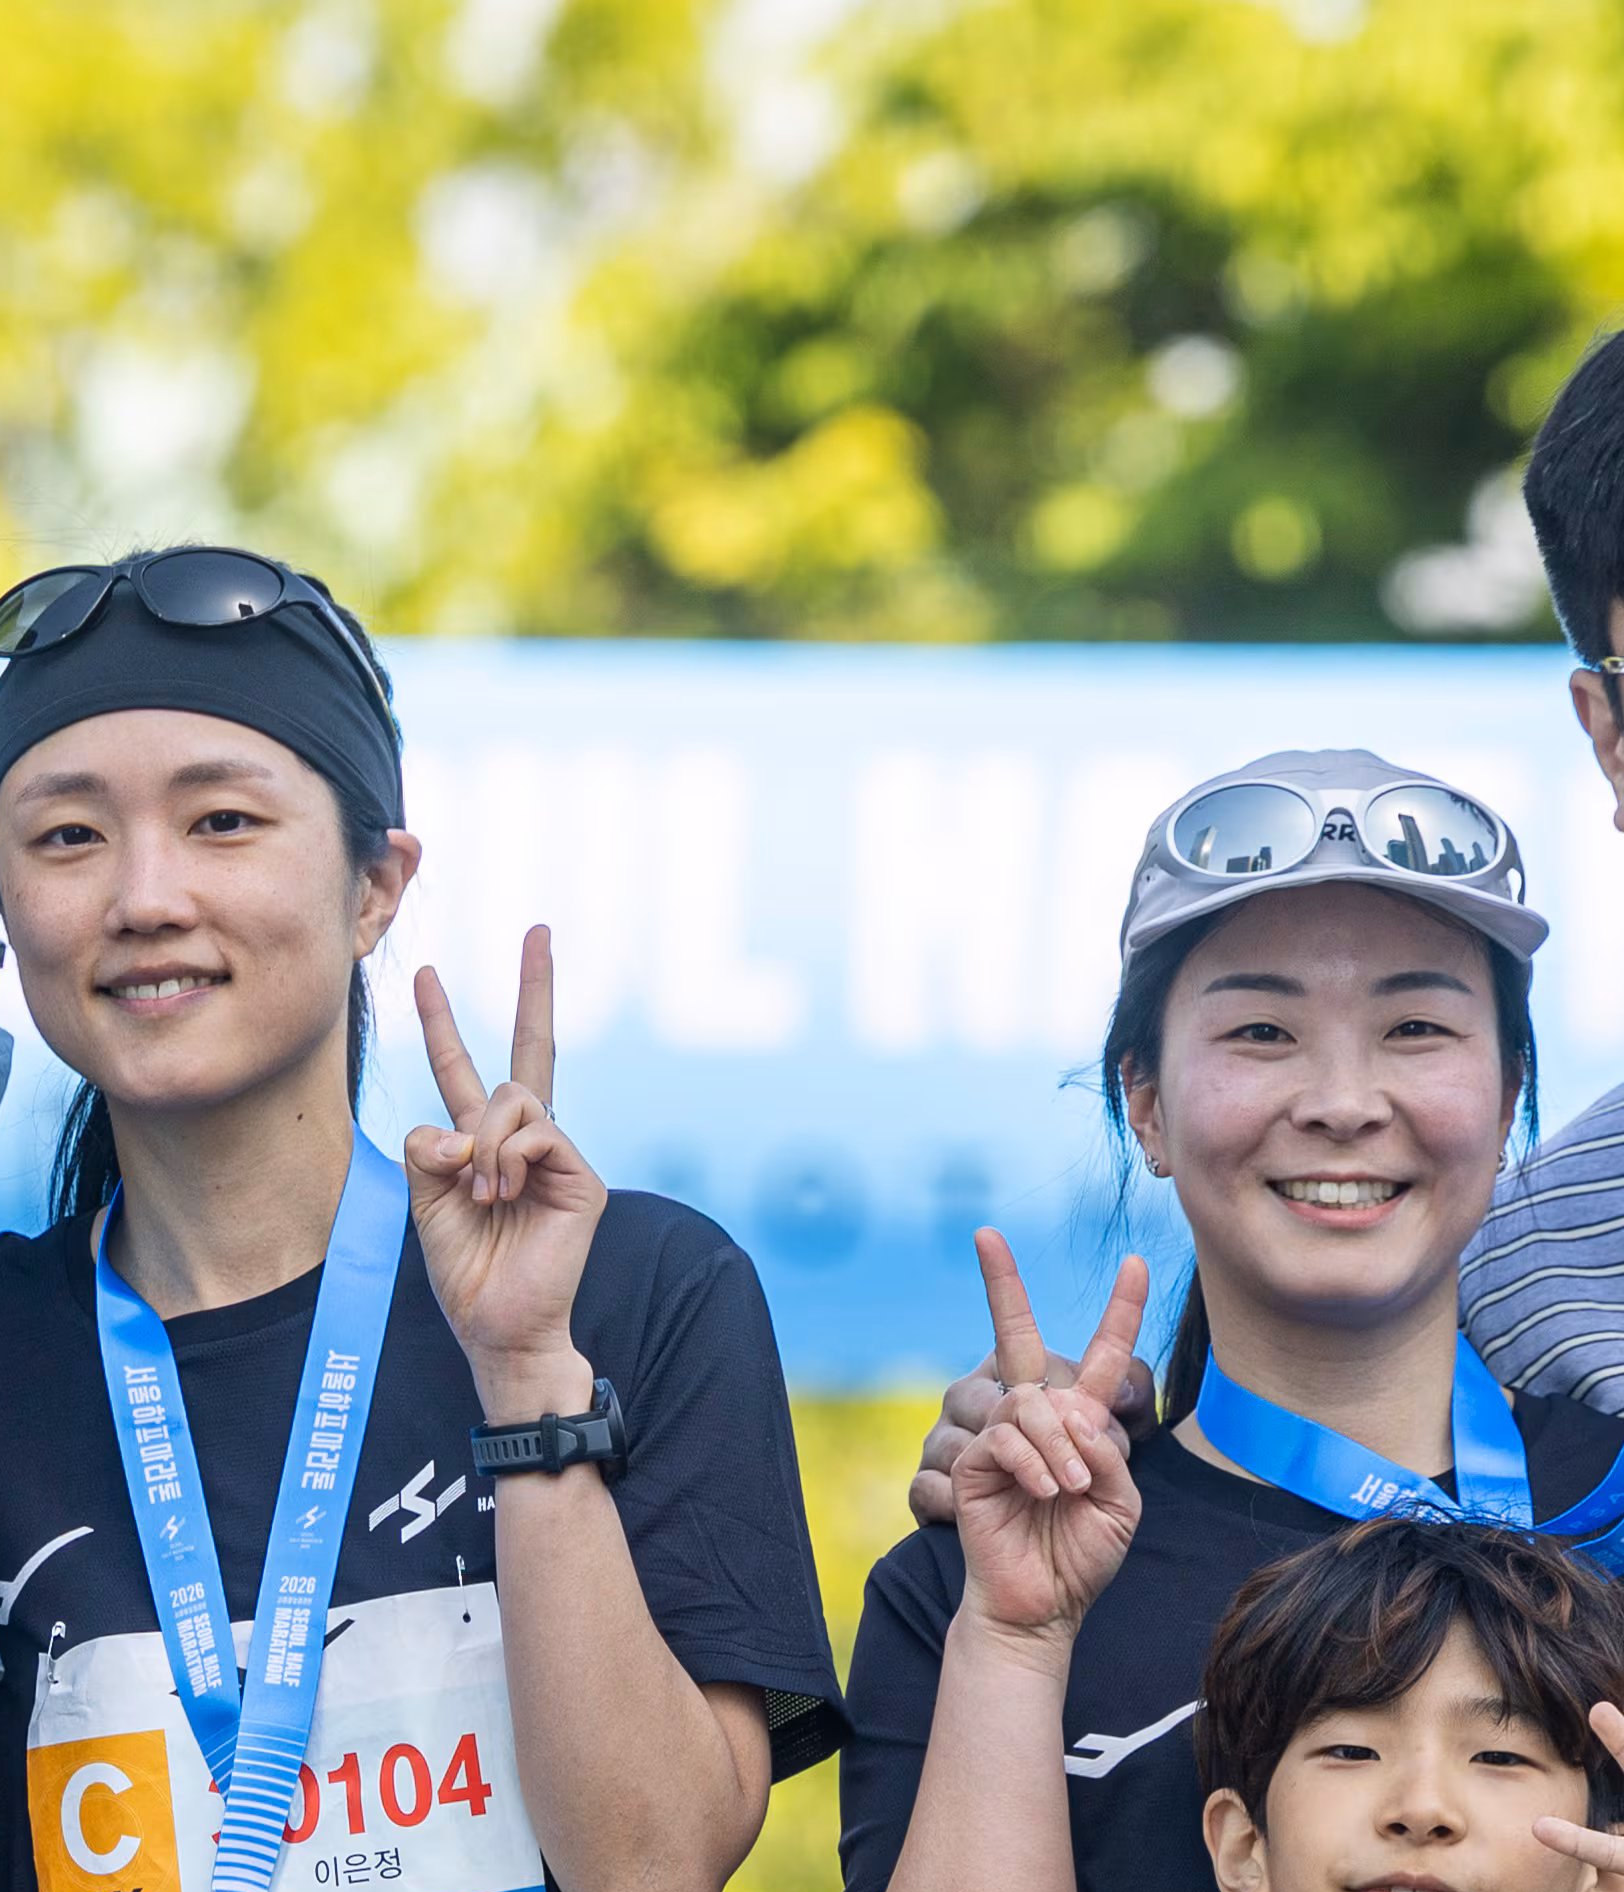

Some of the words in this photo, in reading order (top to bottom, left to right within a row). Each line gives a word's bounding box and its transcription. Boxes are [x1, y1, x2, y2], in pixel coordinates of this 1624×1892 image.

[123, 1365, 182, 1505] 서울하프마라톤
[301, 1349, 360, 1491] 서울하프마라톤
[169, 1581, 206, 1609] 2026
[279, 1575, 317, 1595] 2026
[193, 1612, 215, 1655] SEOUL
[264, 1607, 292, 1686] MARATHON
[288, 1607, 311, 1650] SEOUL
[176, 1617, 209, 1699] MARATHON
[202, 1653, 223, 1689] HALF
[282, 1651, 304, 1689] HALF
[209, 1732, 492, 1844] 0104
[60, 1761, 142, 1876] C
[314, 1847, 403, 1887] 이은정
